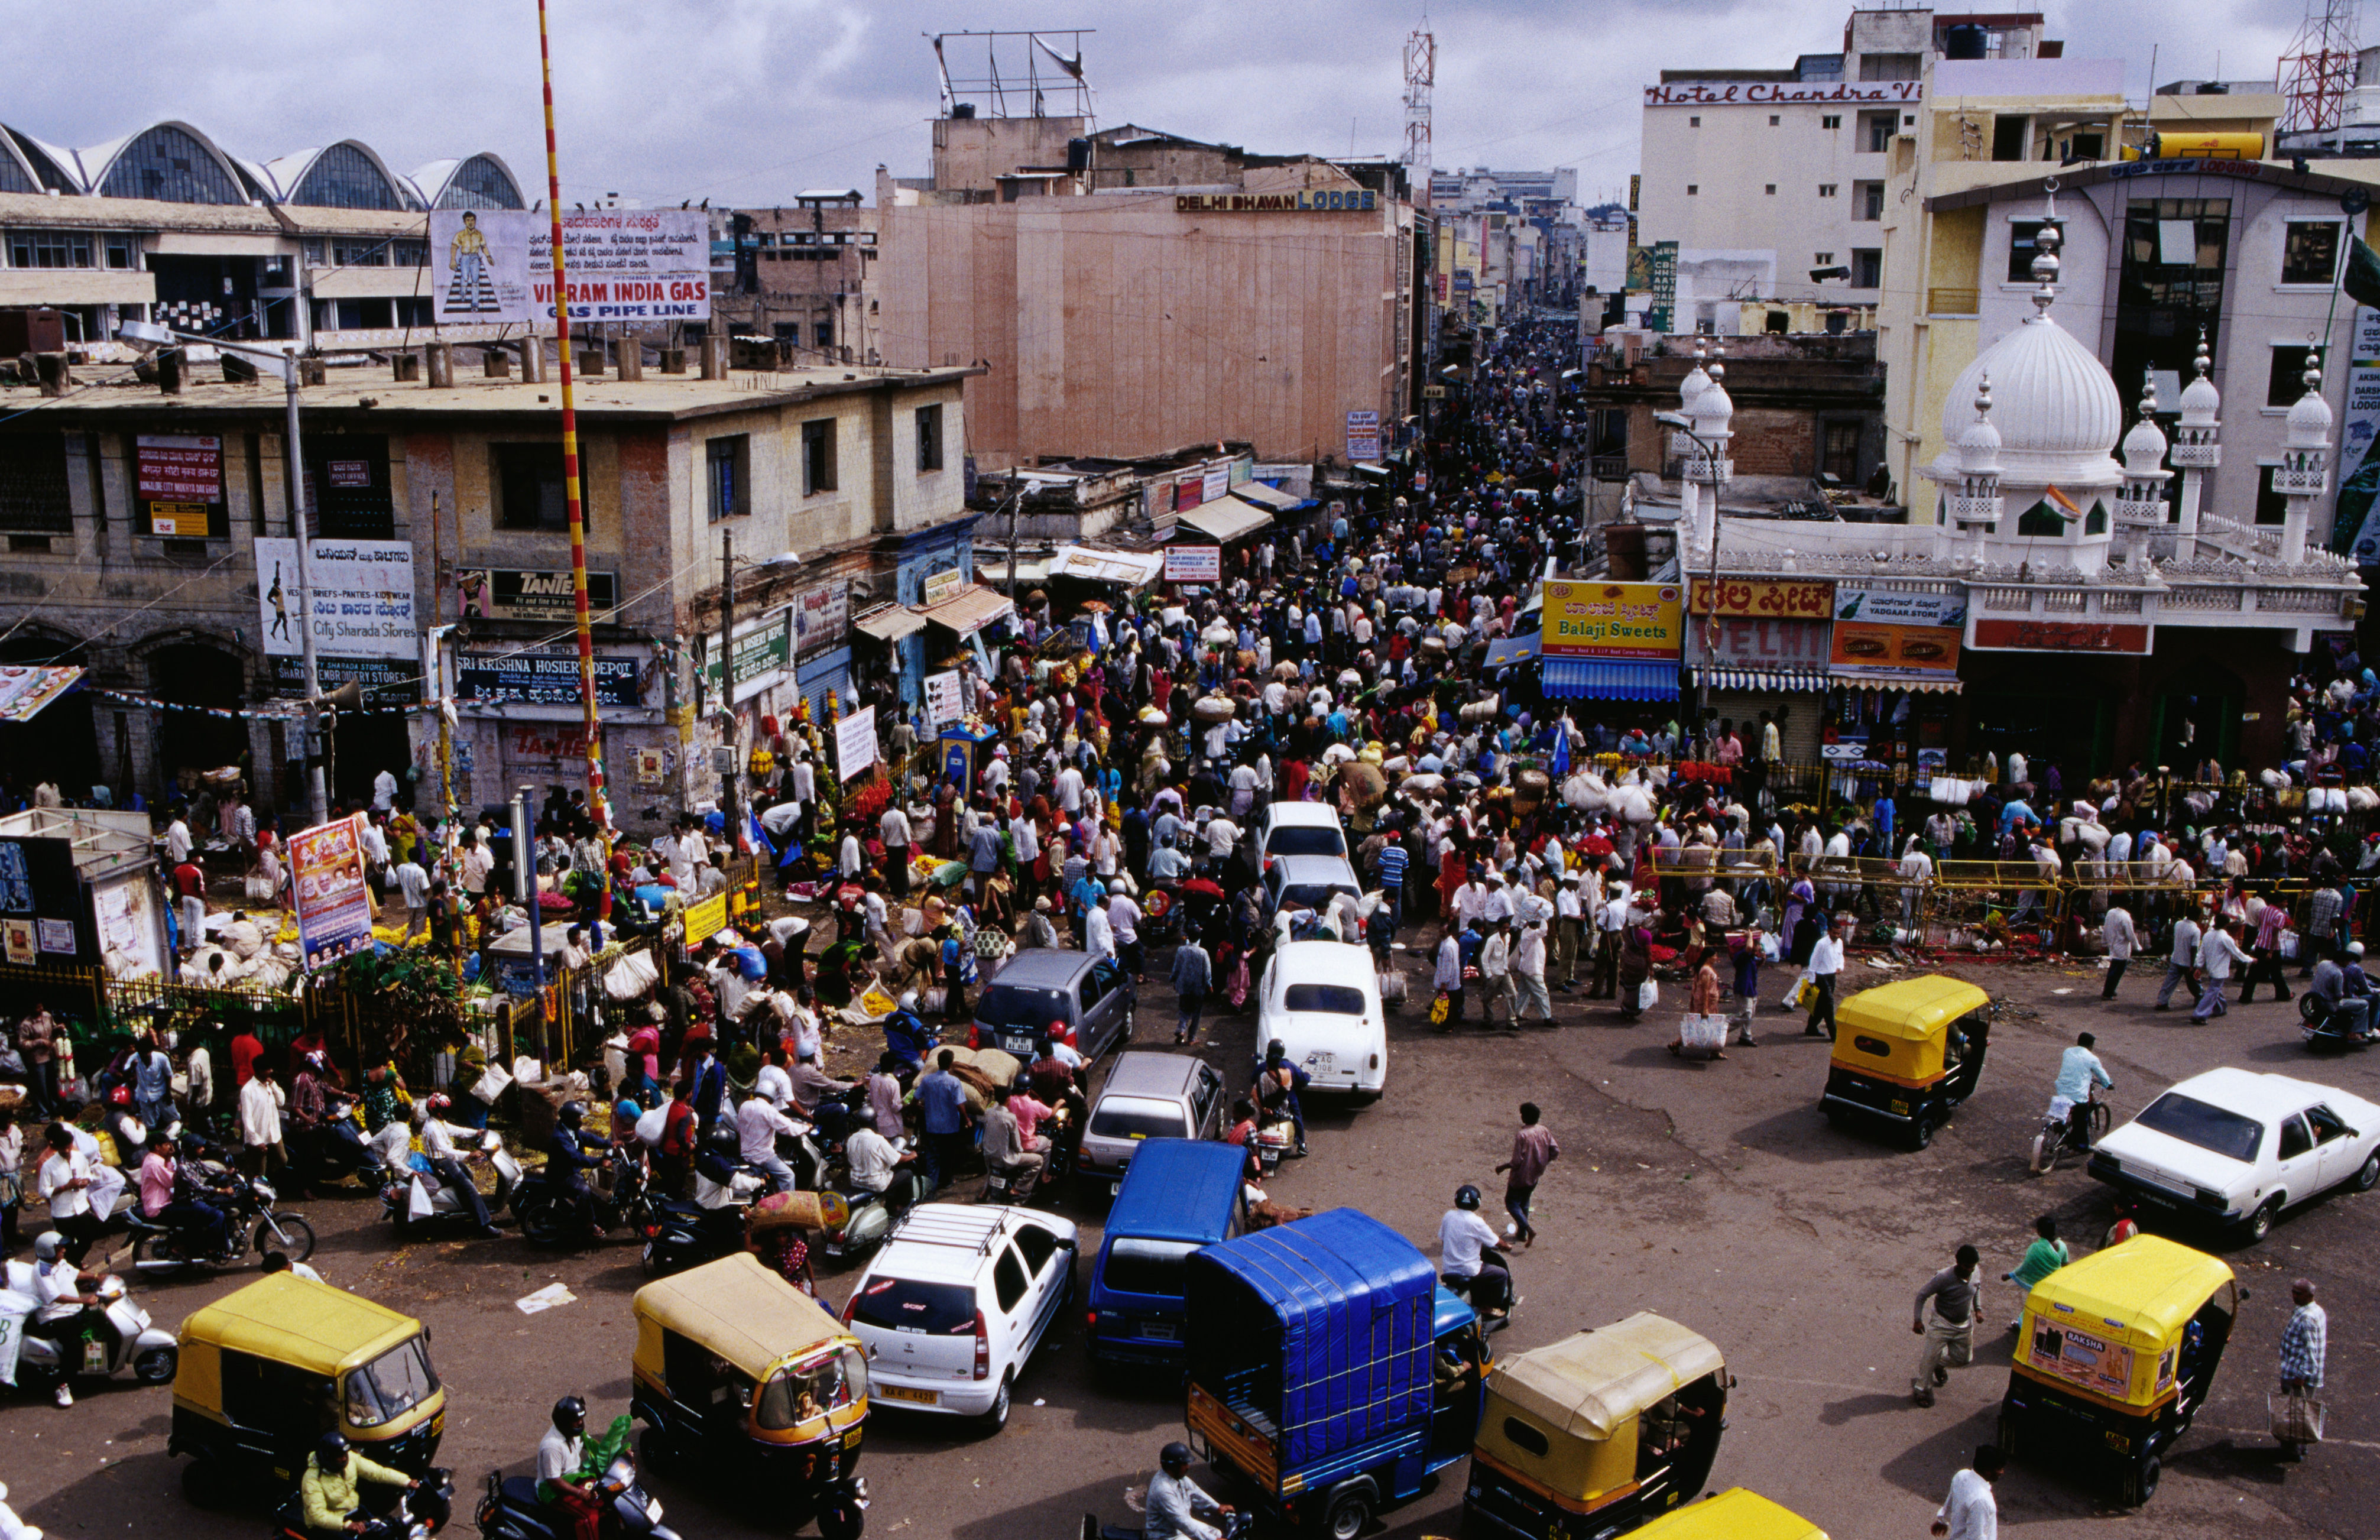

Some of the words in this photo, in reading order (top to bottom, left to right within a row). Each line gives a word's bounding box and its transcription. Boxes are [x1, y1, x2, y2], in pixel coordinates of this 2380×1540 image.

[1646, 85, 1740, 103] Hotel
[1747, 83, 1889, 102] Chandra
[2199, 159, 2261, 175] LODGING
[1176, 195, 1227, 210] DELHI
[1232, 195, 1295, 210] BHAVAN
[1298, 190, 1376, 210] LODGE
[1630, 176, 1639, 210] HOTEL
[1656, 247, 1677, 257] NEW
[533, 283, 608, 303] VIRAM
[614, 282, 665, 301] INDIA
[670, 281, 706, 301] GAS
[1653, 261, 1662, 315] CHANDRA
[598, 305, 648, 317] PIPE
[653, 304, 697, 316] LINE
[163, 482, 174, 491] CITY
[174, 483, 195, 493] MUKHYA
[196, 484, 205, 494] DAK
[206, 485, 219, 494] GHAR
[287, 589, 300, 597] VES
[1565, 601, 1616, 615] ಬಾಲಾಜಿ
[1870, 607, 1909, 617] YADGAAR
[1911, 608, 1939, 618] STORE
[313, 620, 335, 640] City
[336, 621, 380, 637] Sharada
[382, 622, 417, 638] Stores
[1559, 621, 1606, 641] Balaji
[1610, 621, 1667, 638] Sweets
[1695, 621, 1820, 657] DELHI
[550, 646, 573, 654] BRIEFS
[278, 669, 305, 680] SHARA
[478, 658, 531, 673] KRISHNA
[593, 662, 631, 675] DEPOT
[2067, 1332, 2104, 1351] RAKSHA
[885, 1387, 895, 1395] KA
[913, 1390, 933, 1402] 4420
